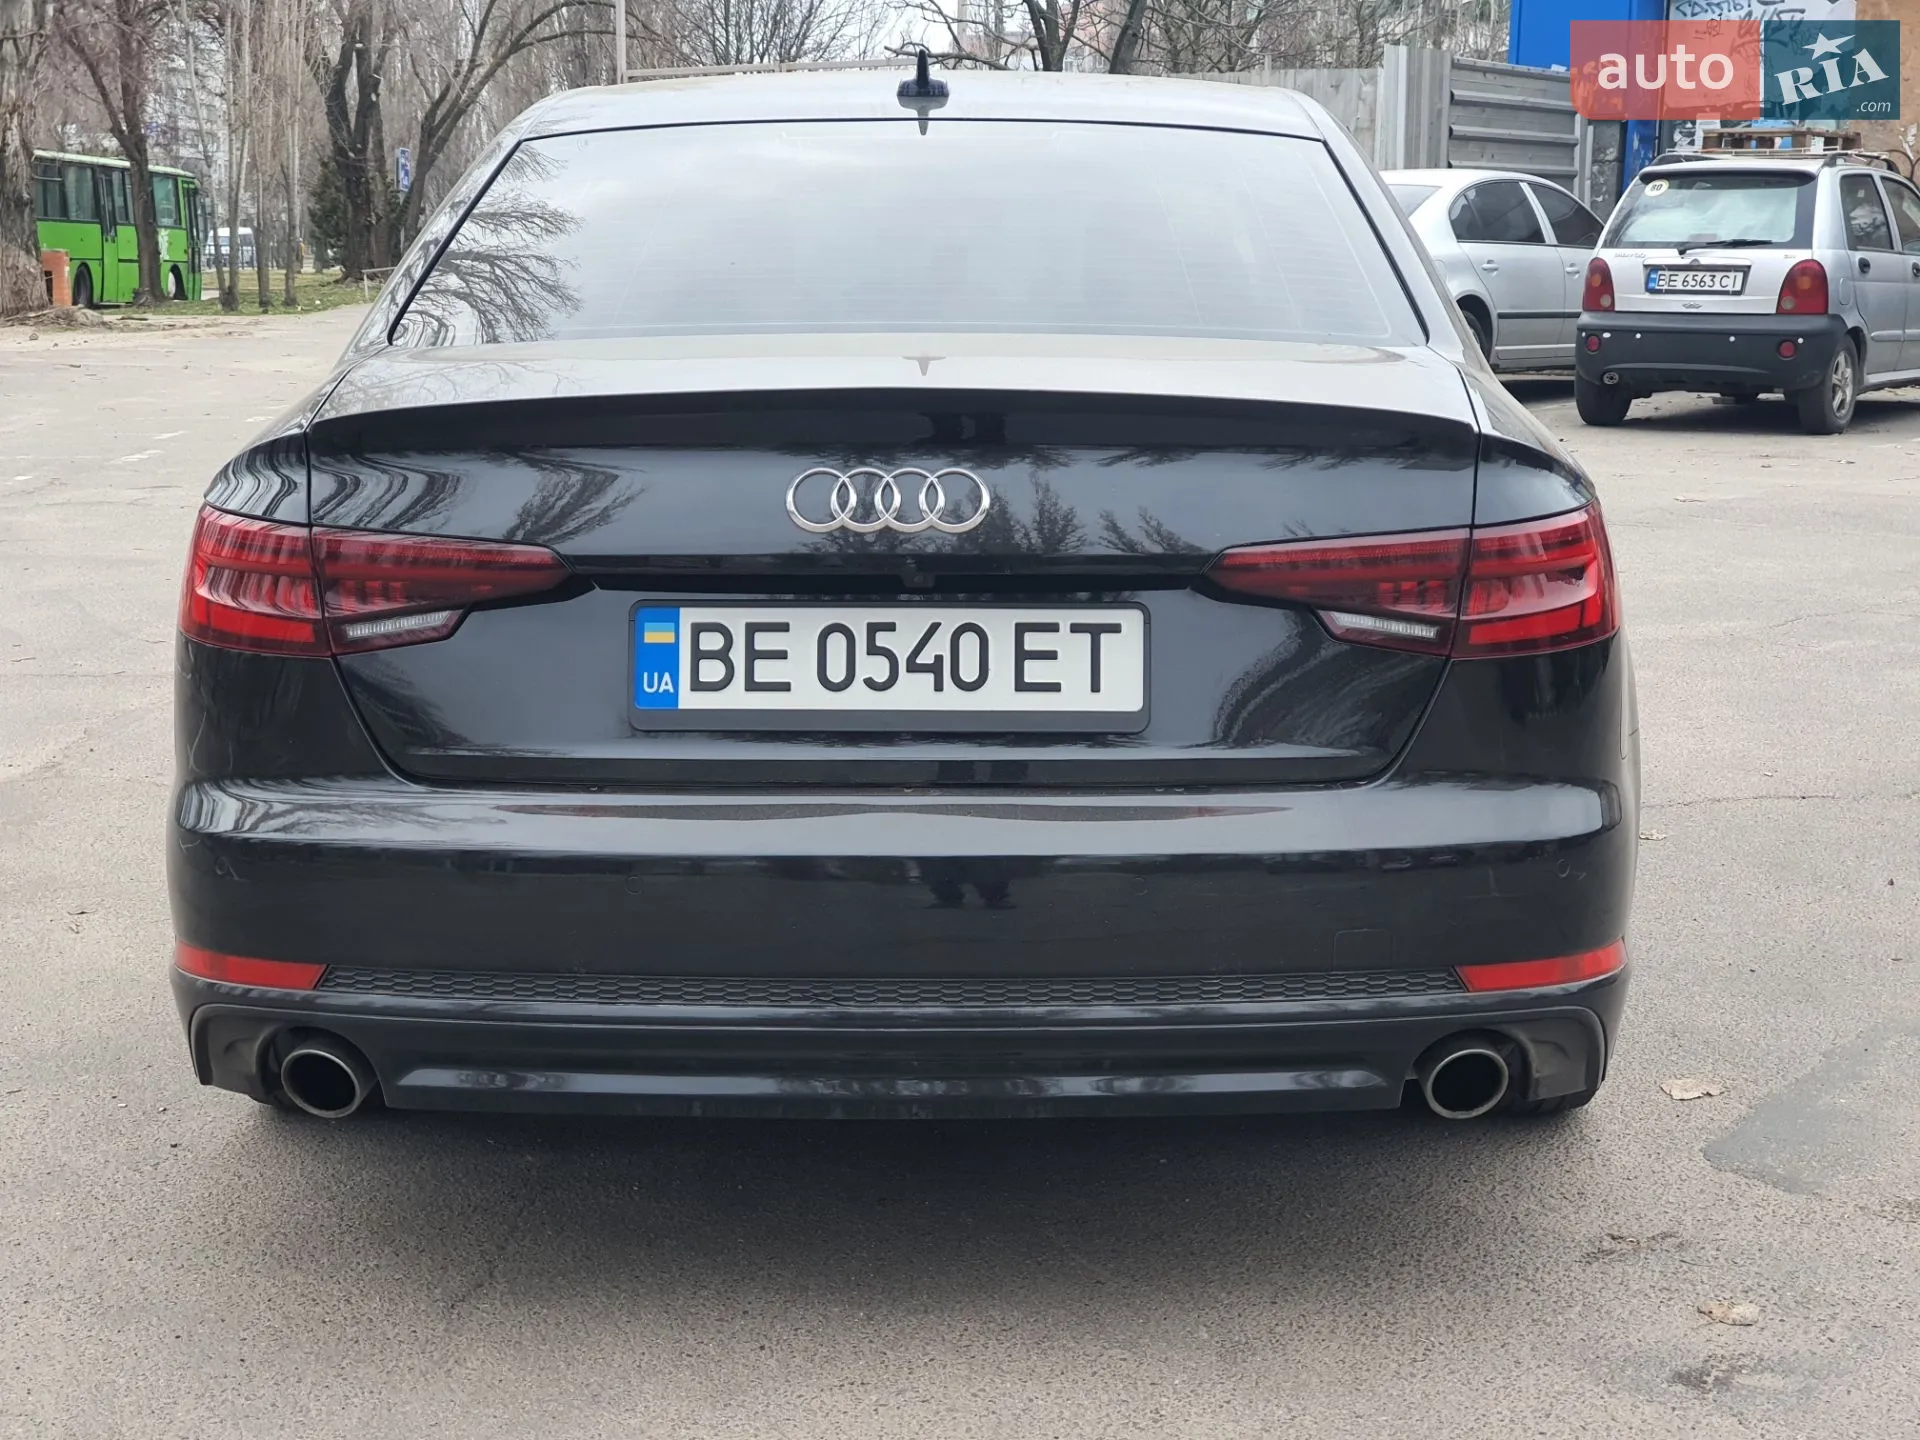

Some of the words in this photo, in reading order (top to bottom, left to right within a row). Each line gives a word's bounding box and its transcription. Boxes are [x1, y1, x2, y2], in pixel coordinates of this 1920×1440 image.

[1656, 273, 1679, 288] BE
[1681, 273, 1716, 289] 6563
[1719, 274, 1737, 289] CI
[690, 622, 791, 692] BE
[816, 622, 989, 692] 0540
[1014, 622, 1122, 692] ET
[643, 671, 674, 693] UA
